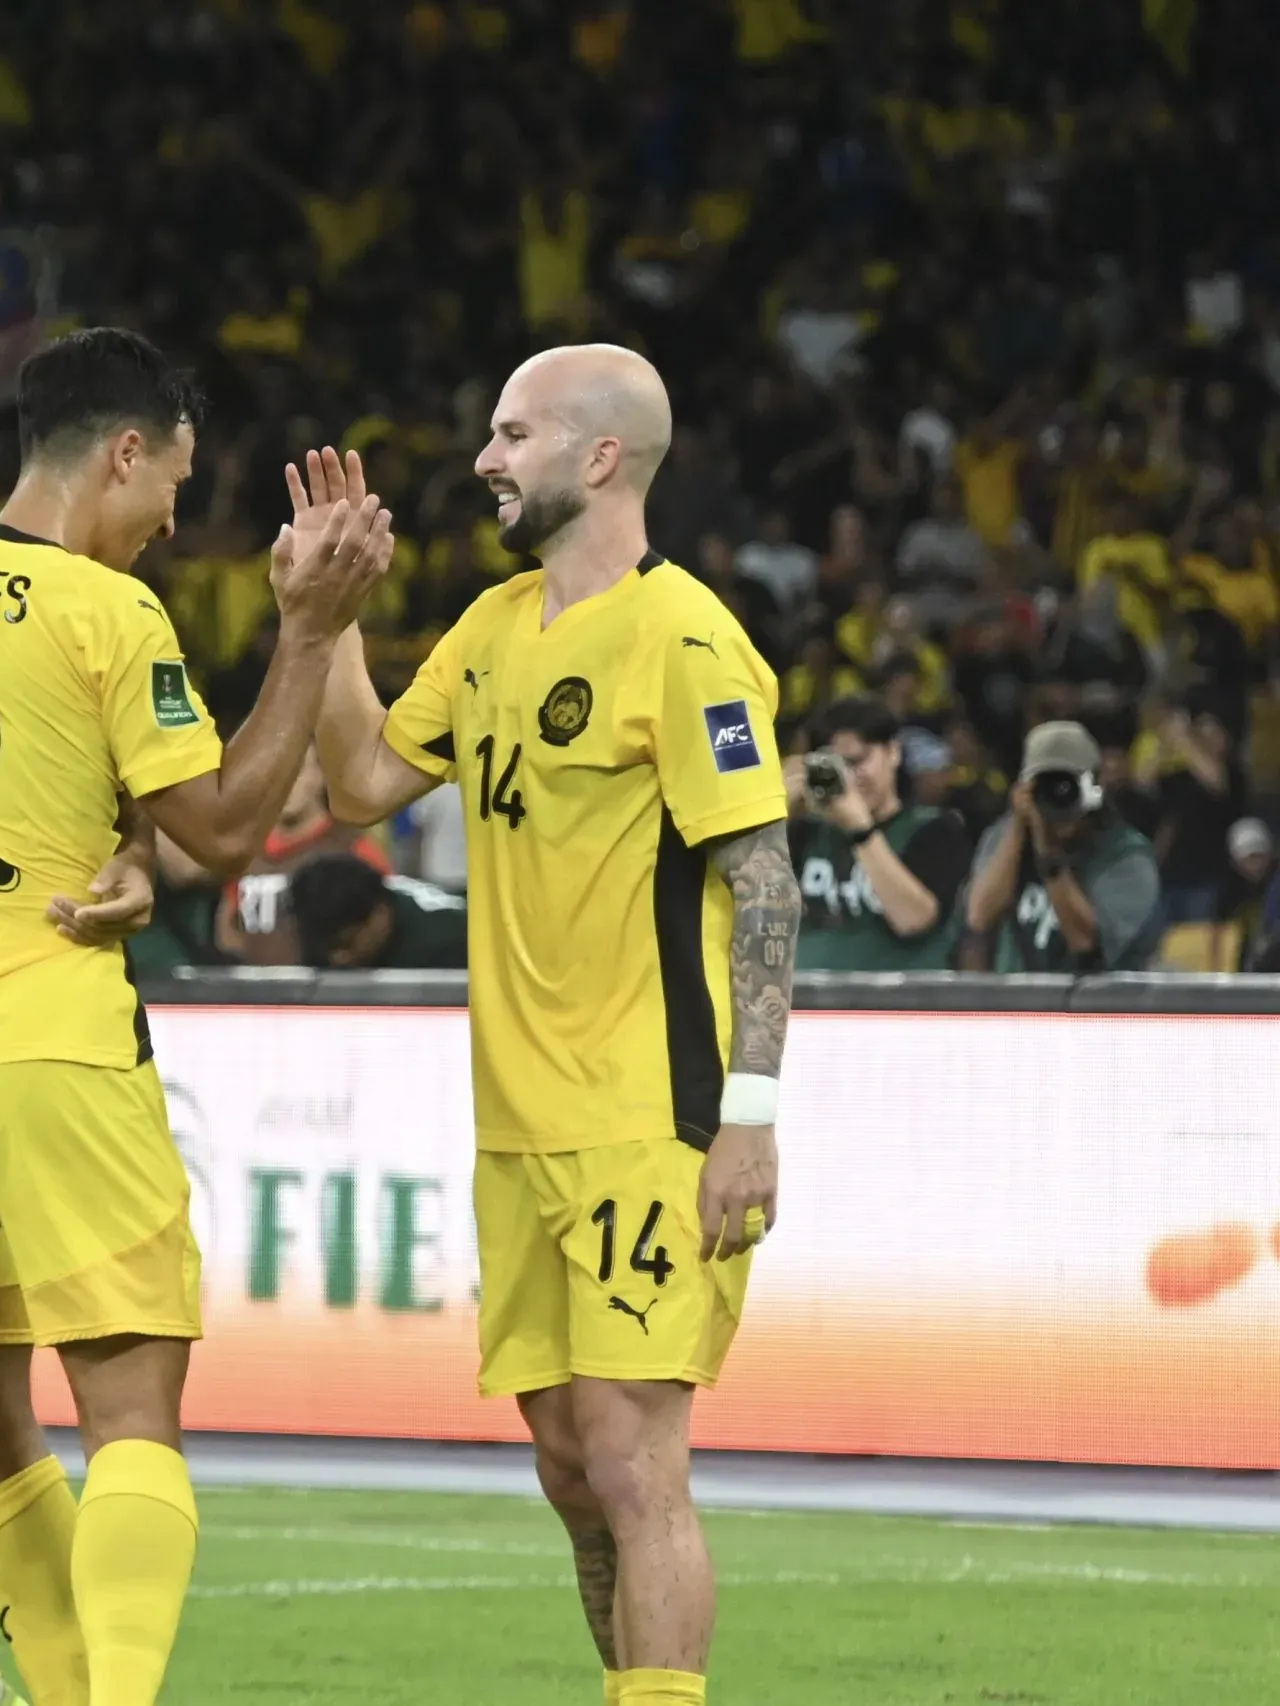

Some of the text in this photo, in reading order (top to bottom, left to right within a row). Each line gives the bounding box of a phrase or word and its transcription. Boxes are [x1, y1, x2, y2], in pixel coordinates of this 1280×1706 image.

[475, 733, 527, 832] 14
[714, 723, 749, 747] AFC
[246, 1164, 477, 1314] FIE
[589, 1197, 677, 1288] 14
